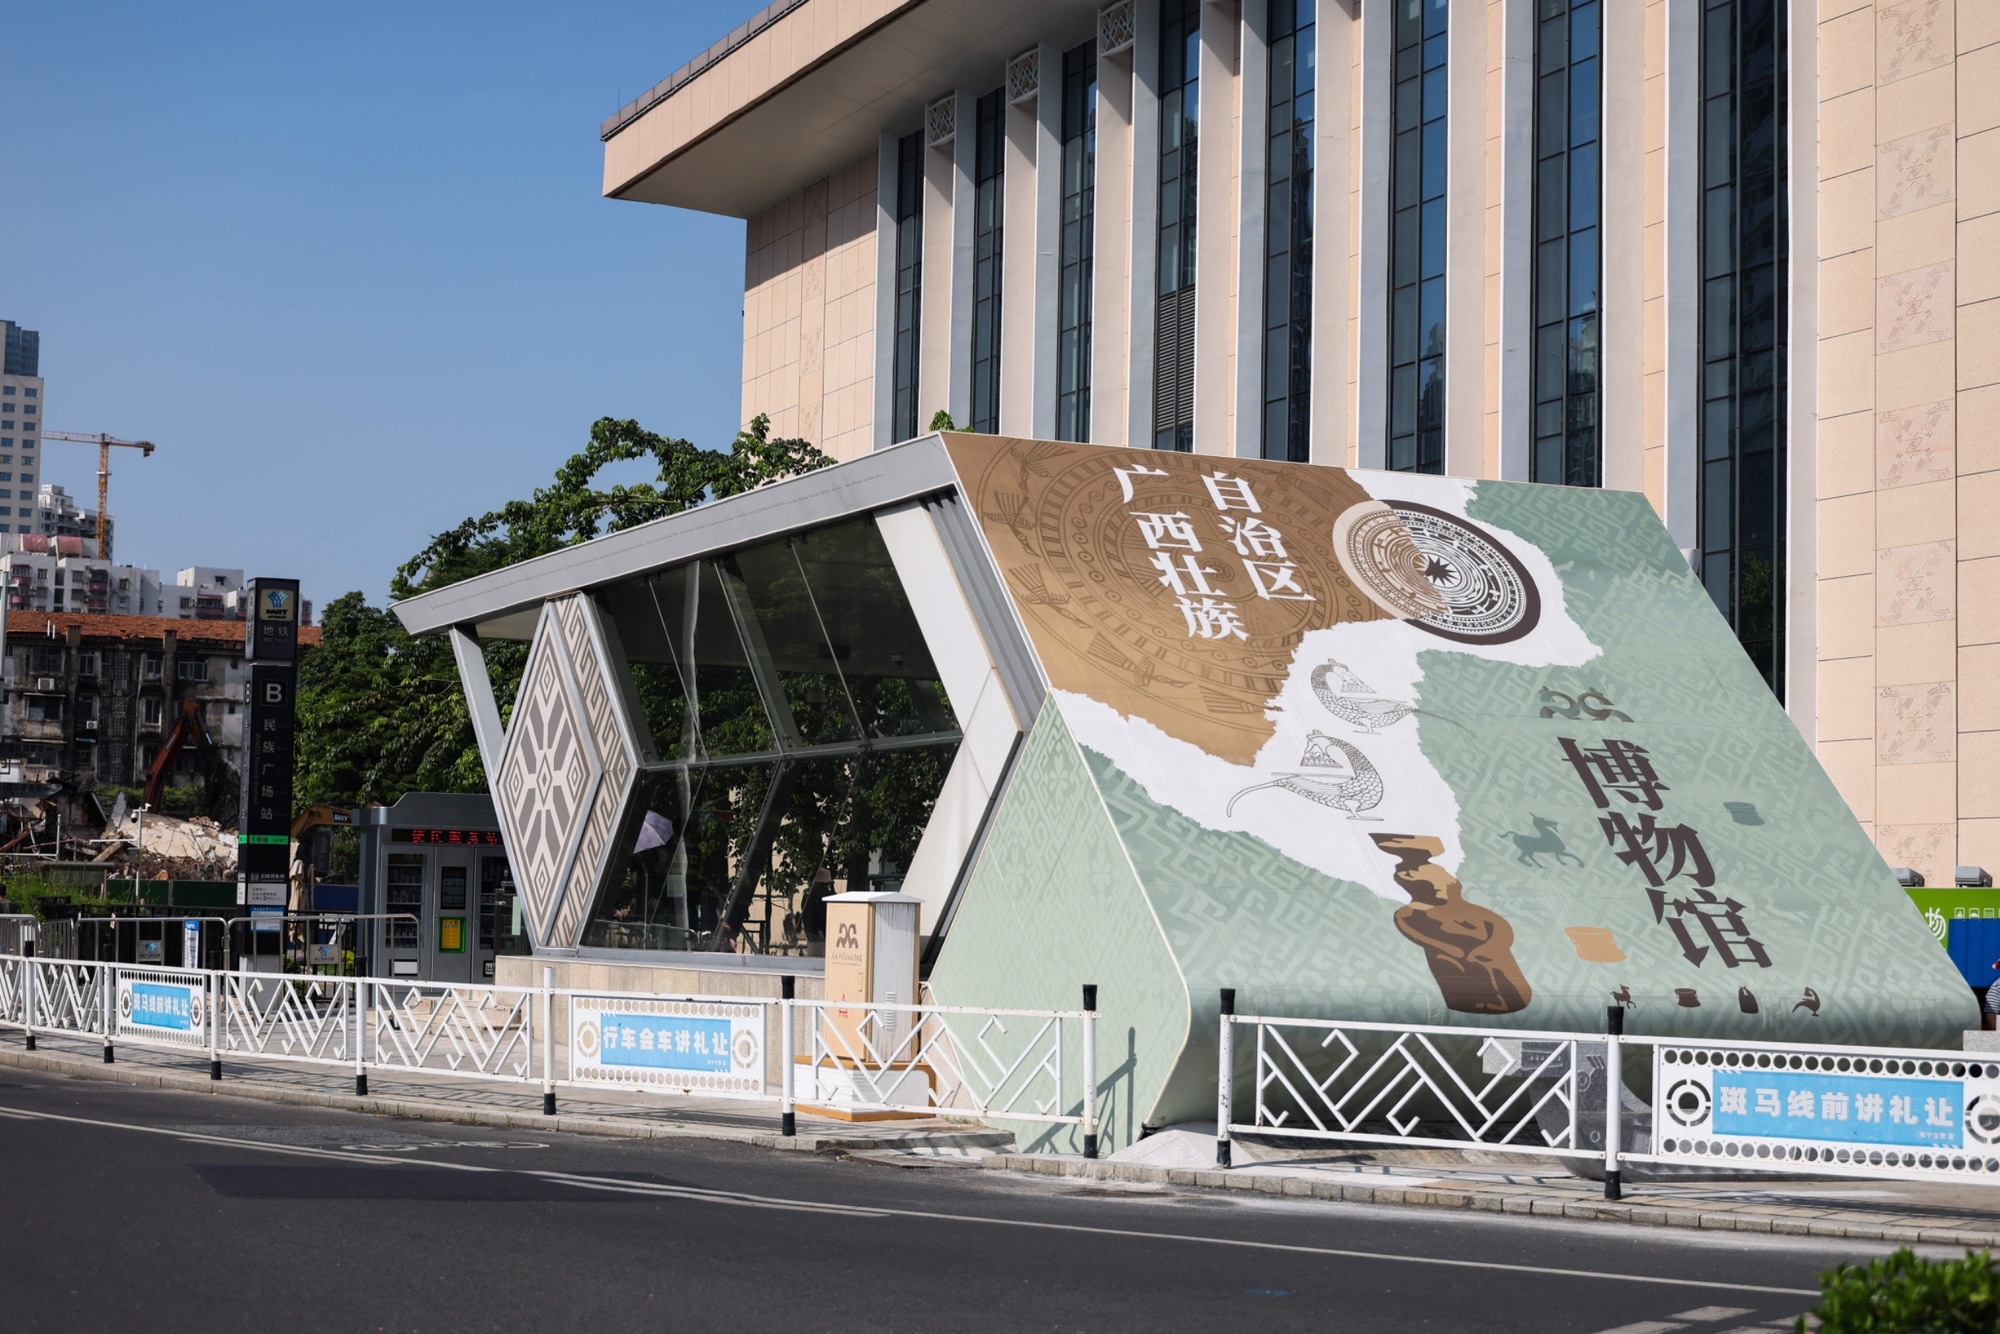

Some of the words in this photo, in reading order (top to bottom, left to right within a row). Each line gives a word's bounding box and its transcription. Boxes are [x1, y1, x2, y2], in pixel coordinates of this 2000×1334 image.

[1113, 464, 1249, 641] 广西壮族
[1200, 471, 1317, 601] 自治区
[263, 625, 288, 637] 地铁
[266, 683, 282, 702] B
[260, 719, 276, 820] 民族广场站
[1557, 736, 1772, 969] 博物馆
[603, 1026, 728, 1055] 行车会车讲礼让
[1720, 1086, 1954, 1127] 斑马线前讲礼让
